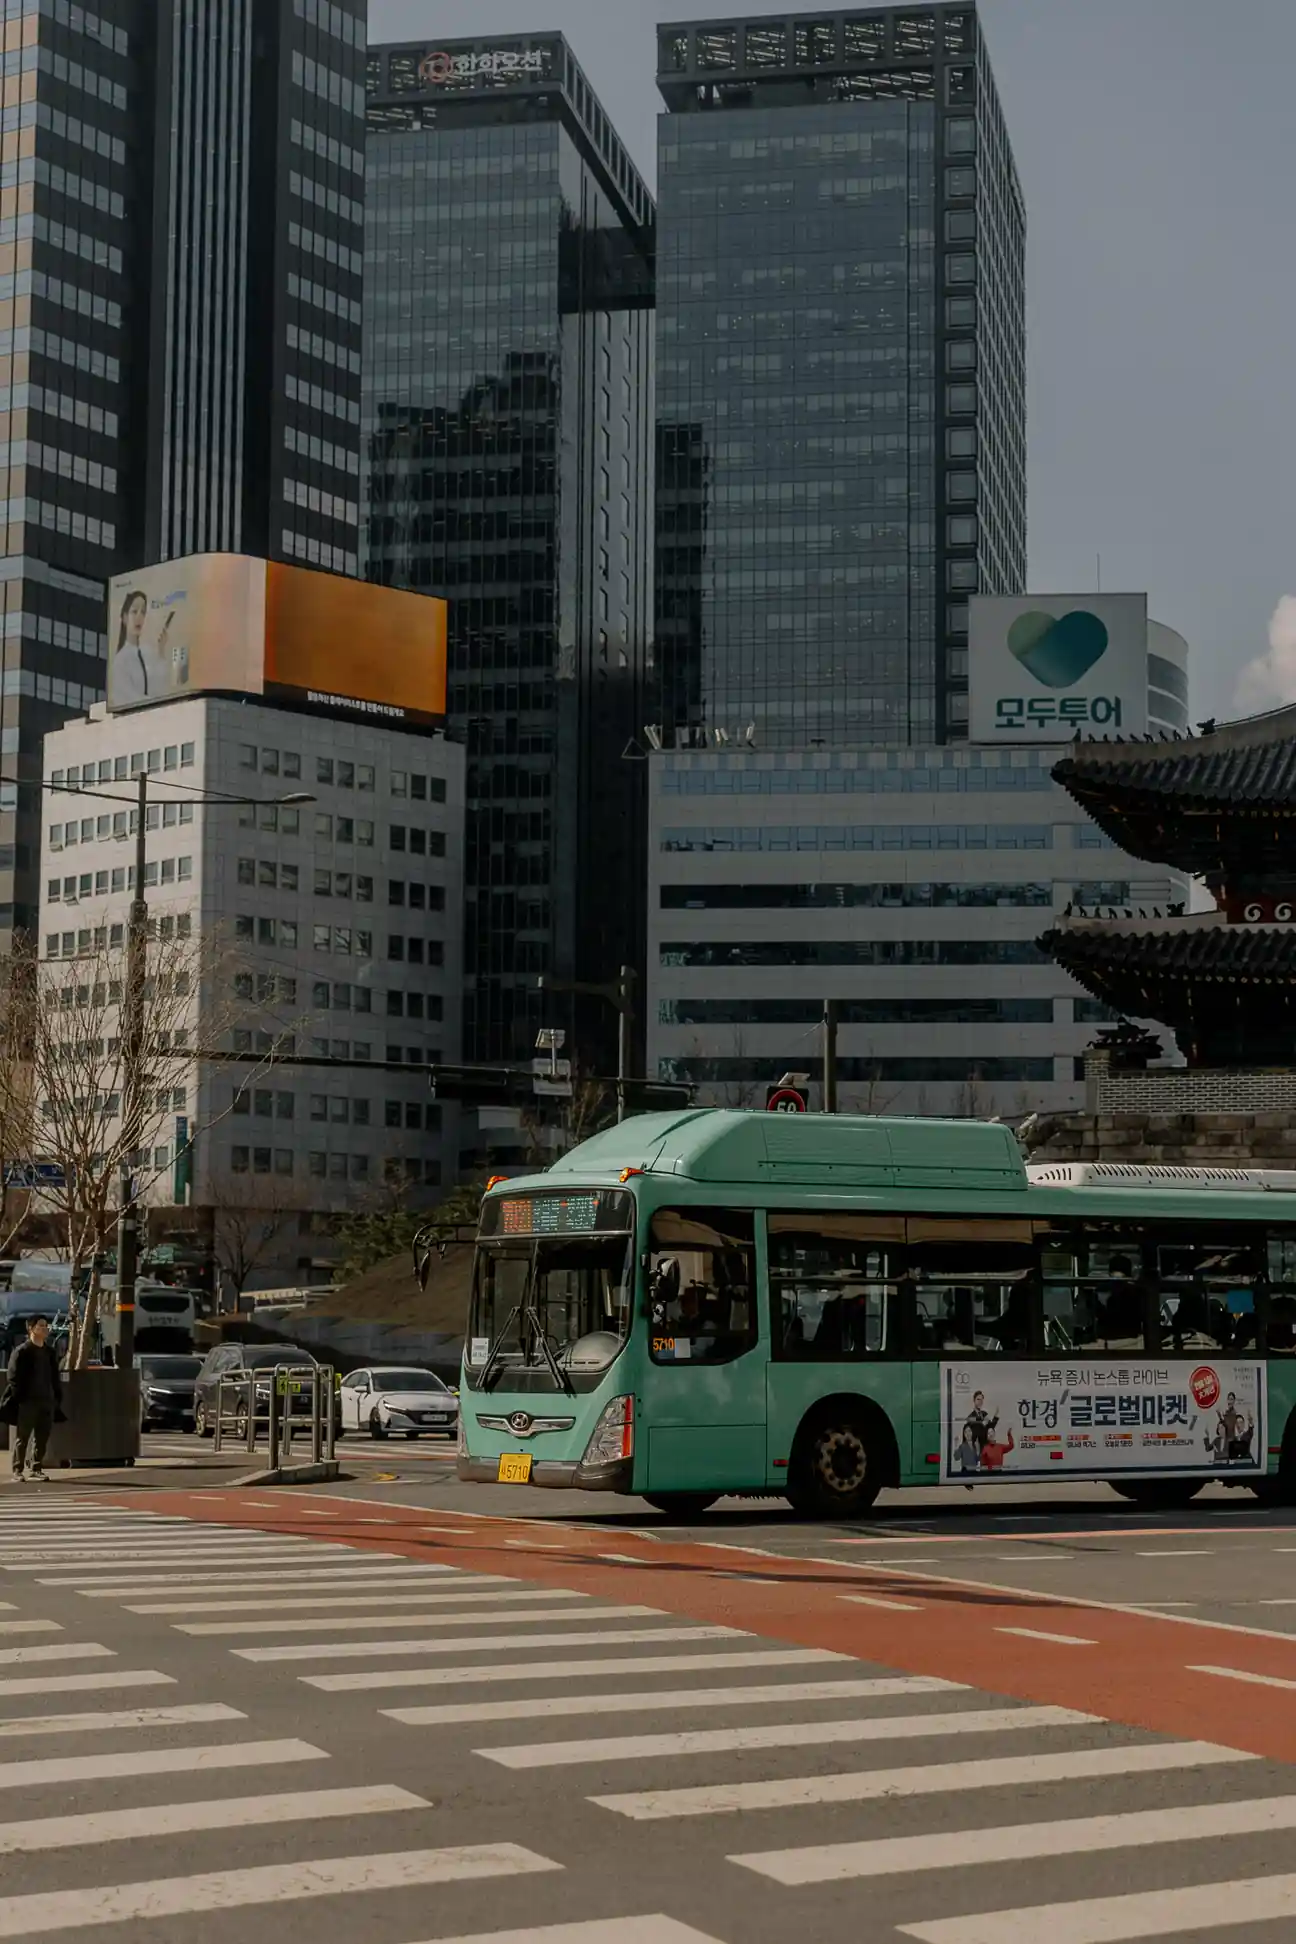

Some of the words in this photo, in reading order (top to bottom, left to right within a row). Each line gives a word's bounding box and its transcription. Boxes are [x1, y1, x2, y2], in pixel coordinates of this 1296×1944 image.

[995, 696, 1122, 729] 모두투어
[653, 1337, 675, 1351] 5710
[1037, 1370, 1063, 1387] 뉴욕
[1065, 1370, 1091, 1386] 증시
[1093, 1370, 1131, 1386] 논스톱
[1133, 1369, 1170, 1386] 라이브
[1017, 1399, 1058, 1428] 한경
